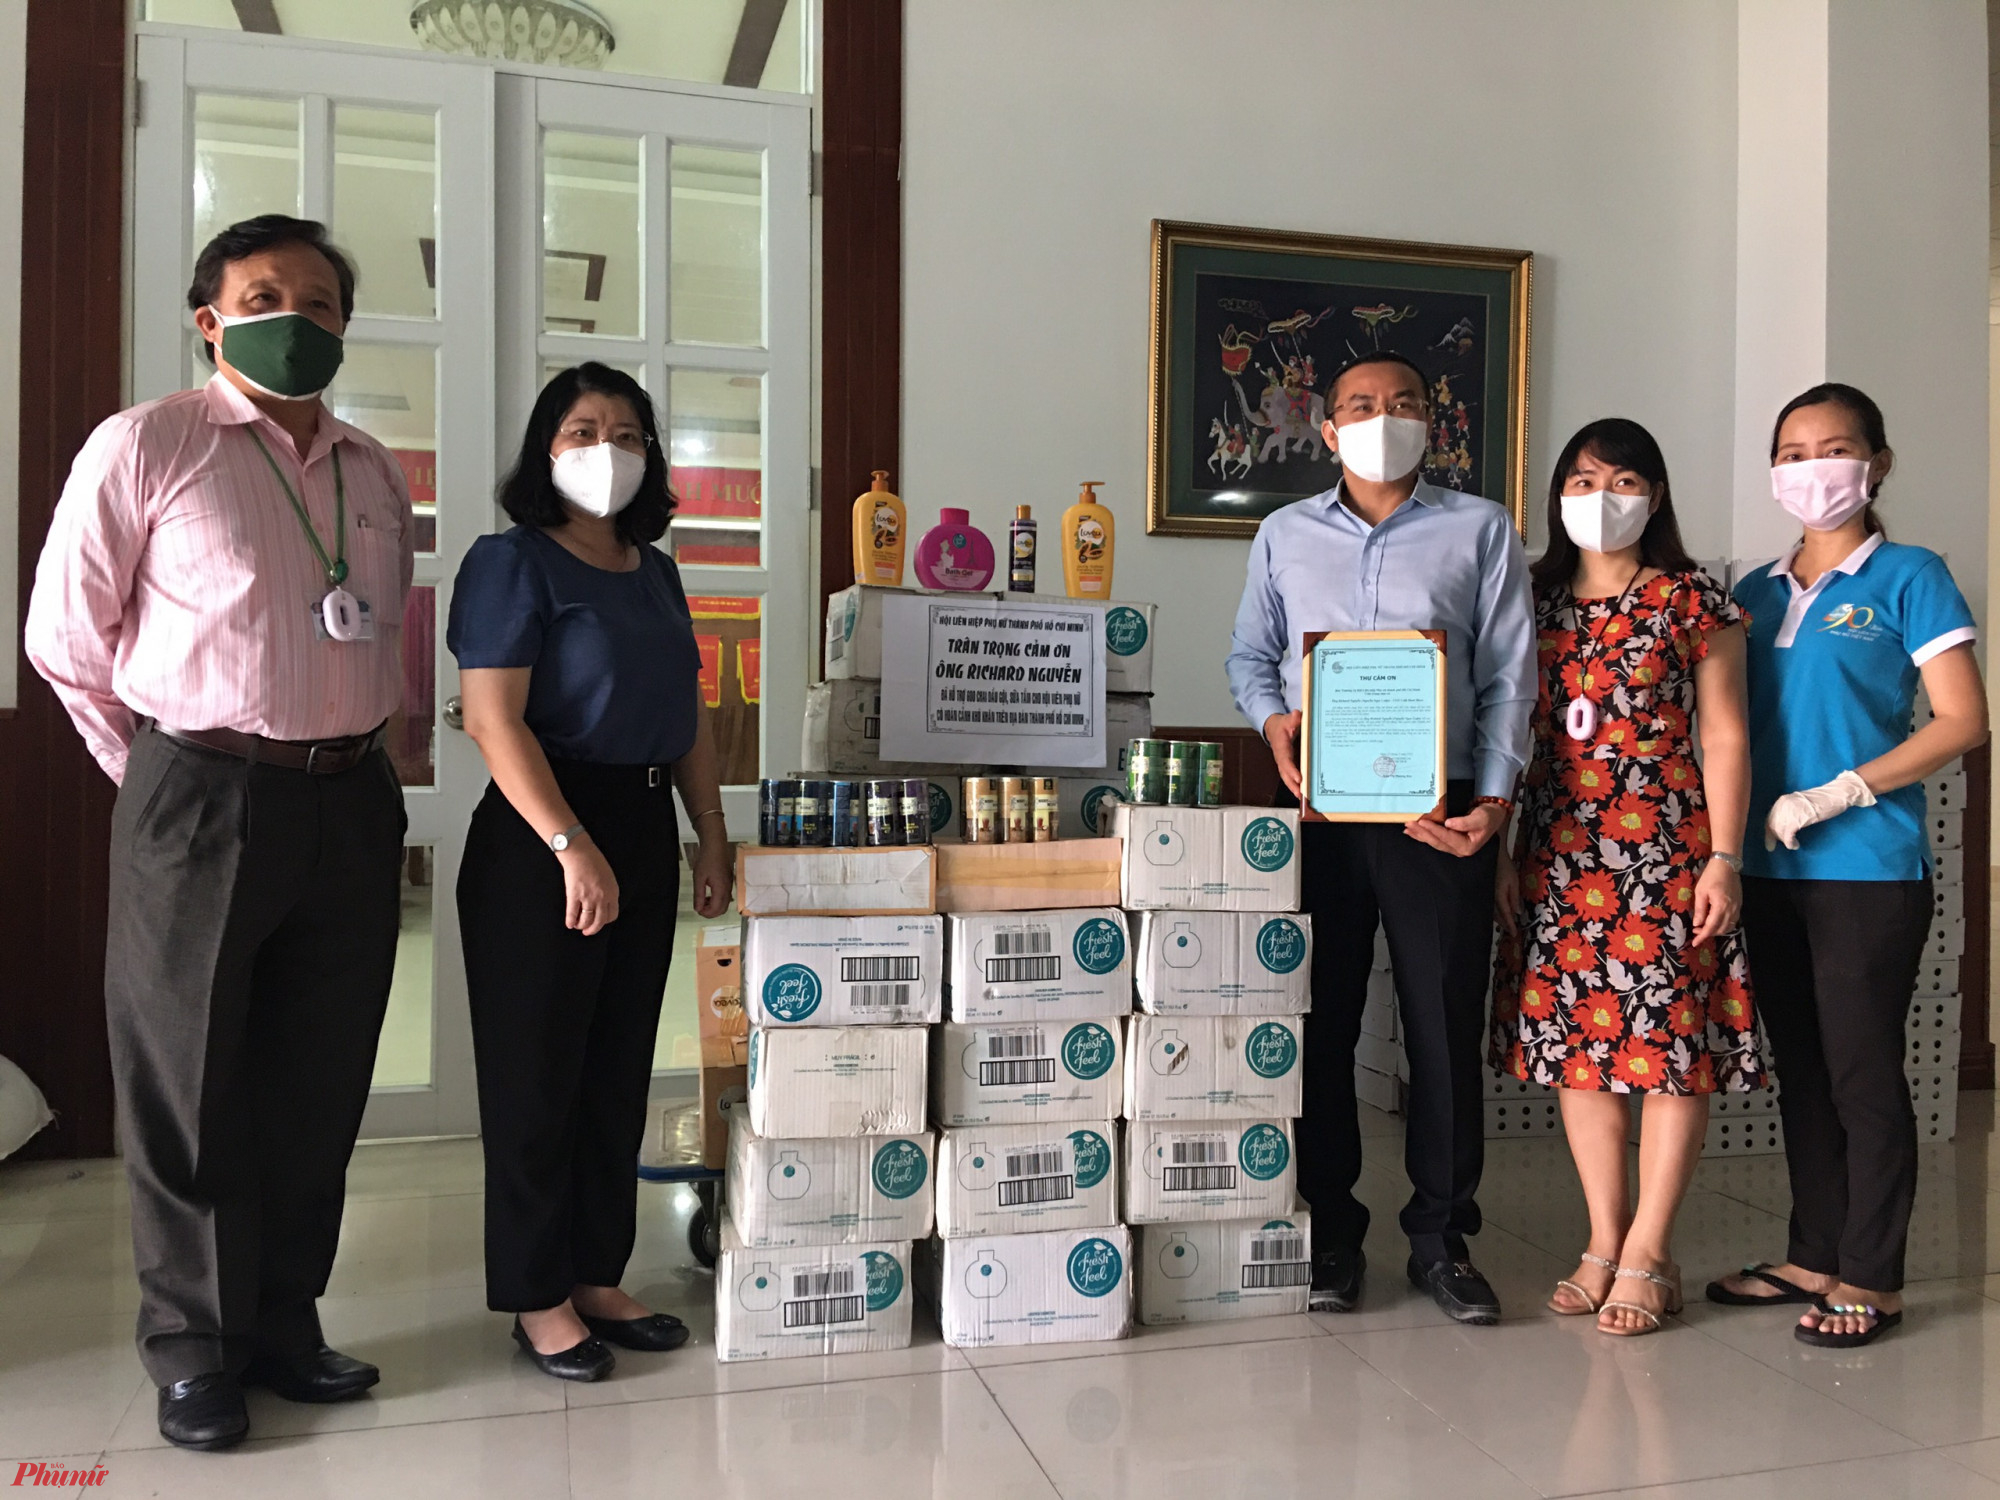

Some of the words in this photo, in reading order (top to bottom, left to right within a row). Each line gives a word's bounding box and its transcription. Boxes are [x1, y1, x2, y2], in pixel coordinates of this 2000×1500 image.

[945, 568, 960, 576] Bath
[939, 614, 951, 626] HỘI
[952, 615, 967, 626] LIÊN
[968, 616, 983, 628] HIỆP
[984, 617, 997, 629] PHỤ
[1030, 619, 1043, 630] PHỐ
[1067, 623, 1083, 632] MINH
[948, 636, 979, 654] TRÂN
[983, 640, 1020, 659] TRỌNG
[1024, 639, 1050, 657] CẢM
[1054, 643, 1071, 658] ƠN
[1112, 630, 1136, 646] feel
[936, 659, 964, 679] ÔNG
[967, 663, 1025, 681] RICHARD
[1028, 663, 1082, 683] NGUYỄN
[1252, 829, 1282, 849] fresh
[1254, 843, 1279, 862] feel
[1084, 931, 1113, 951] fresh
[1267, 930, 1294, 950] fresh
[1086, 945, 1111, 965] feel
[1269, 946, 1292, 964] feel
[1072, 1035, 1103, 1057] fresh
[1256, 1034, 1285, 1055] fresh
[1074, 1050, 1101, 1070] feel
[1258, 1049, 1283, 1069] feel
[1249, 1136, 1277, 1157] fresh
[883, 1152, 914, 1175] fresh
[1251, 1151, 1276, 1171] feel
[885, 1167, 912, 1190] feel
[1078, 1251, 1109, 1273] fresh
[1080, 1267, 1107, 1288] feel
